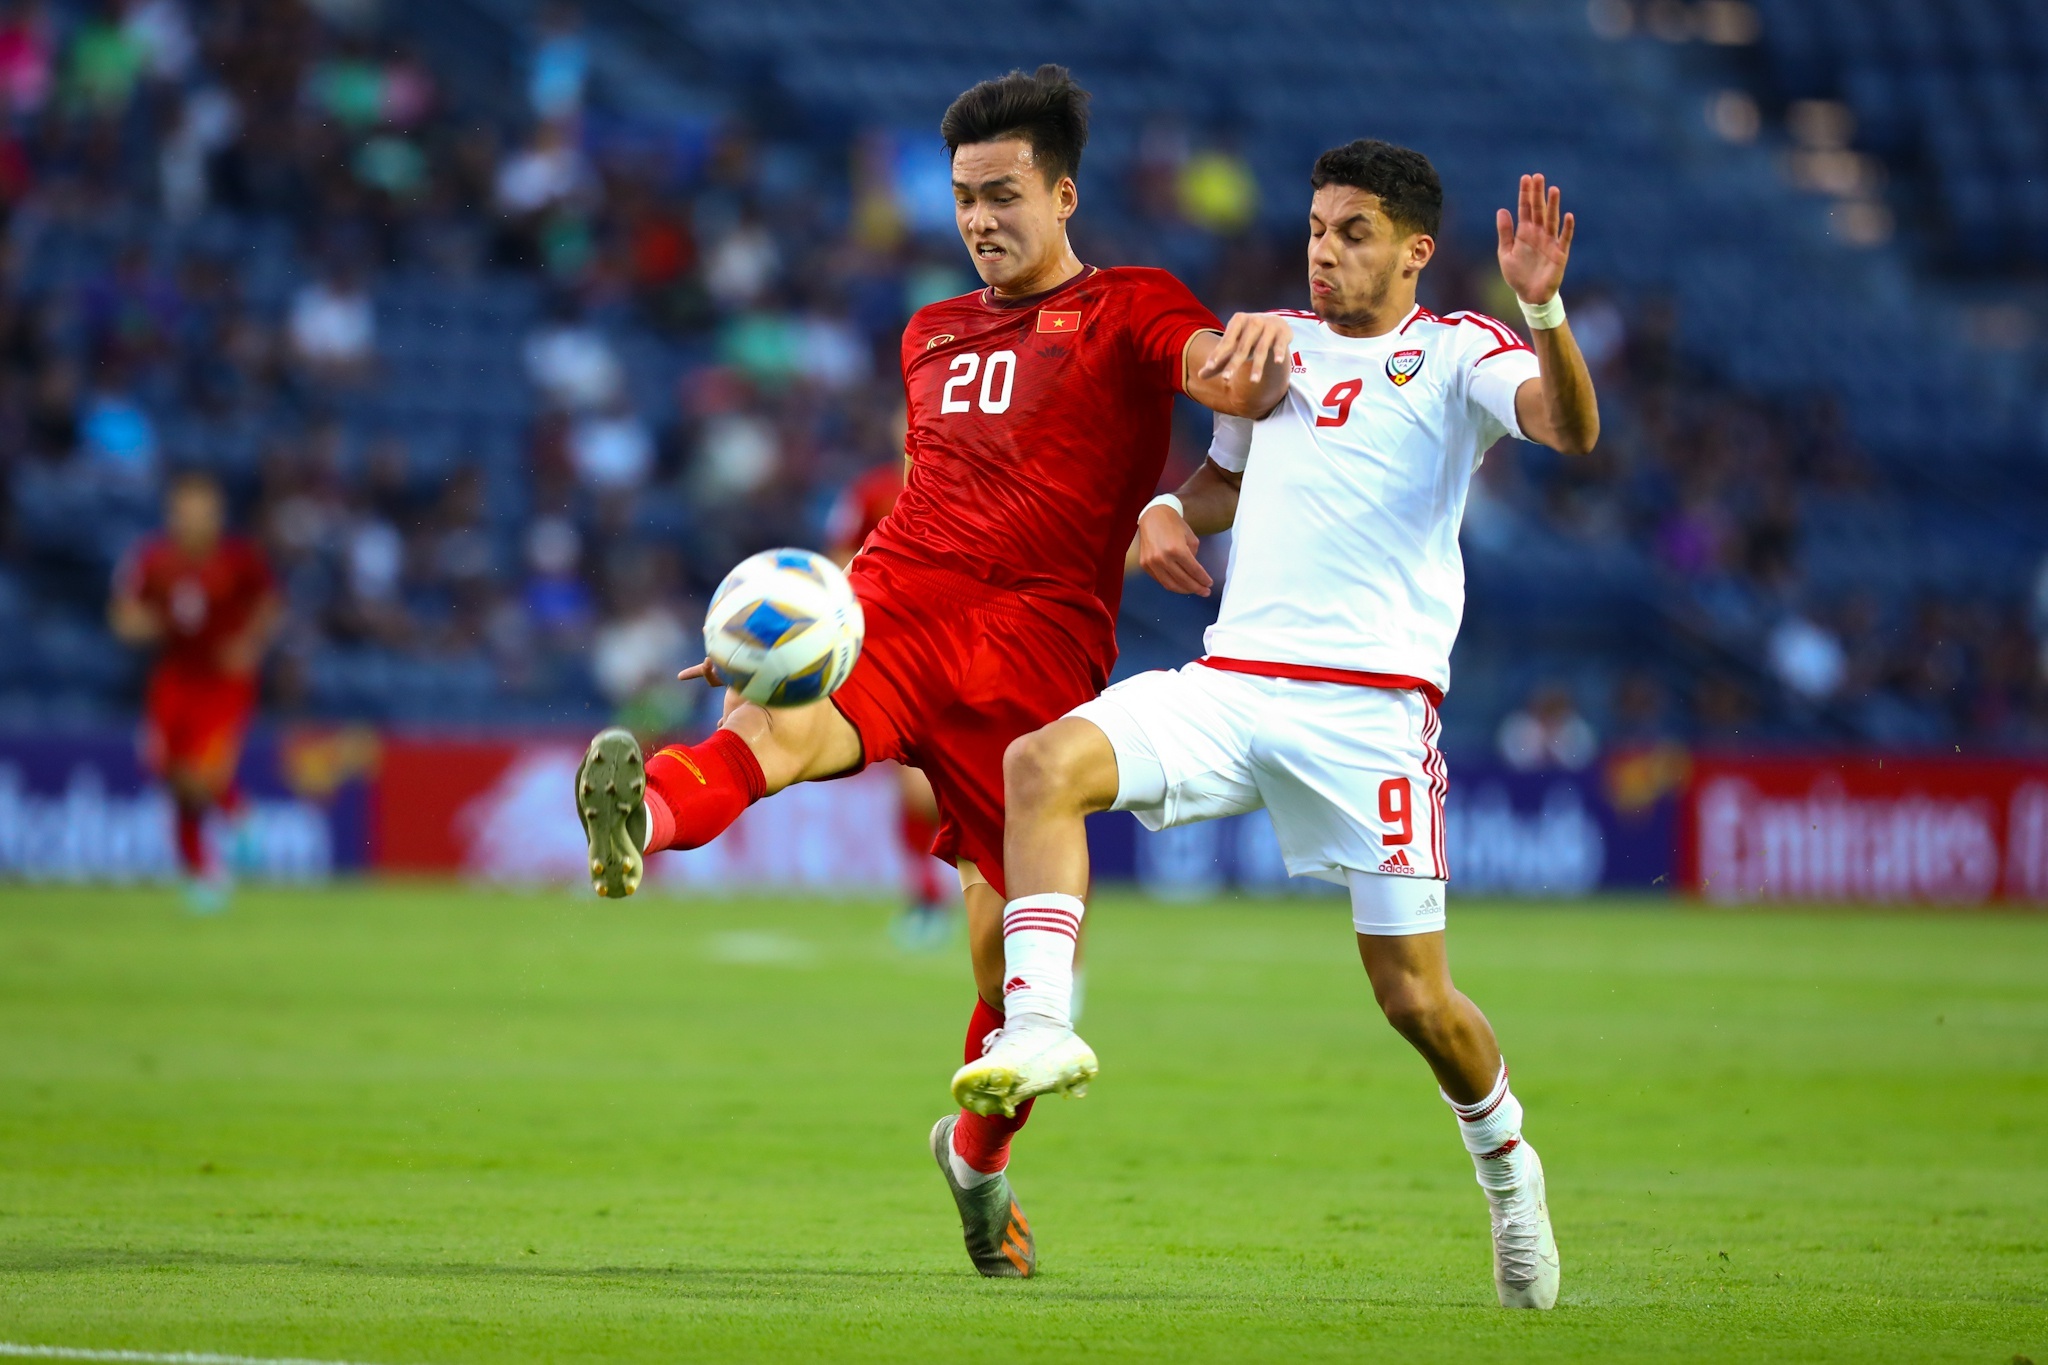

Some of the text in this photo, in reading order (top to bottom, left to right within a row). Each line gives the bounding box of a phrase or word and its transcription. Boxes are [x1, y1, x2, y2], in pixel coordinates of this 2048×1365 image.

[941, 350, 1017, 415] 20
[1290, 365, 1307, 374] das
[1315, 377, 1363, 427] 9
[1378, 776, 1414, 846] 9
[1378, 863, 1415, 875] adidas
[1415, 905, 1442, 916] adidas
